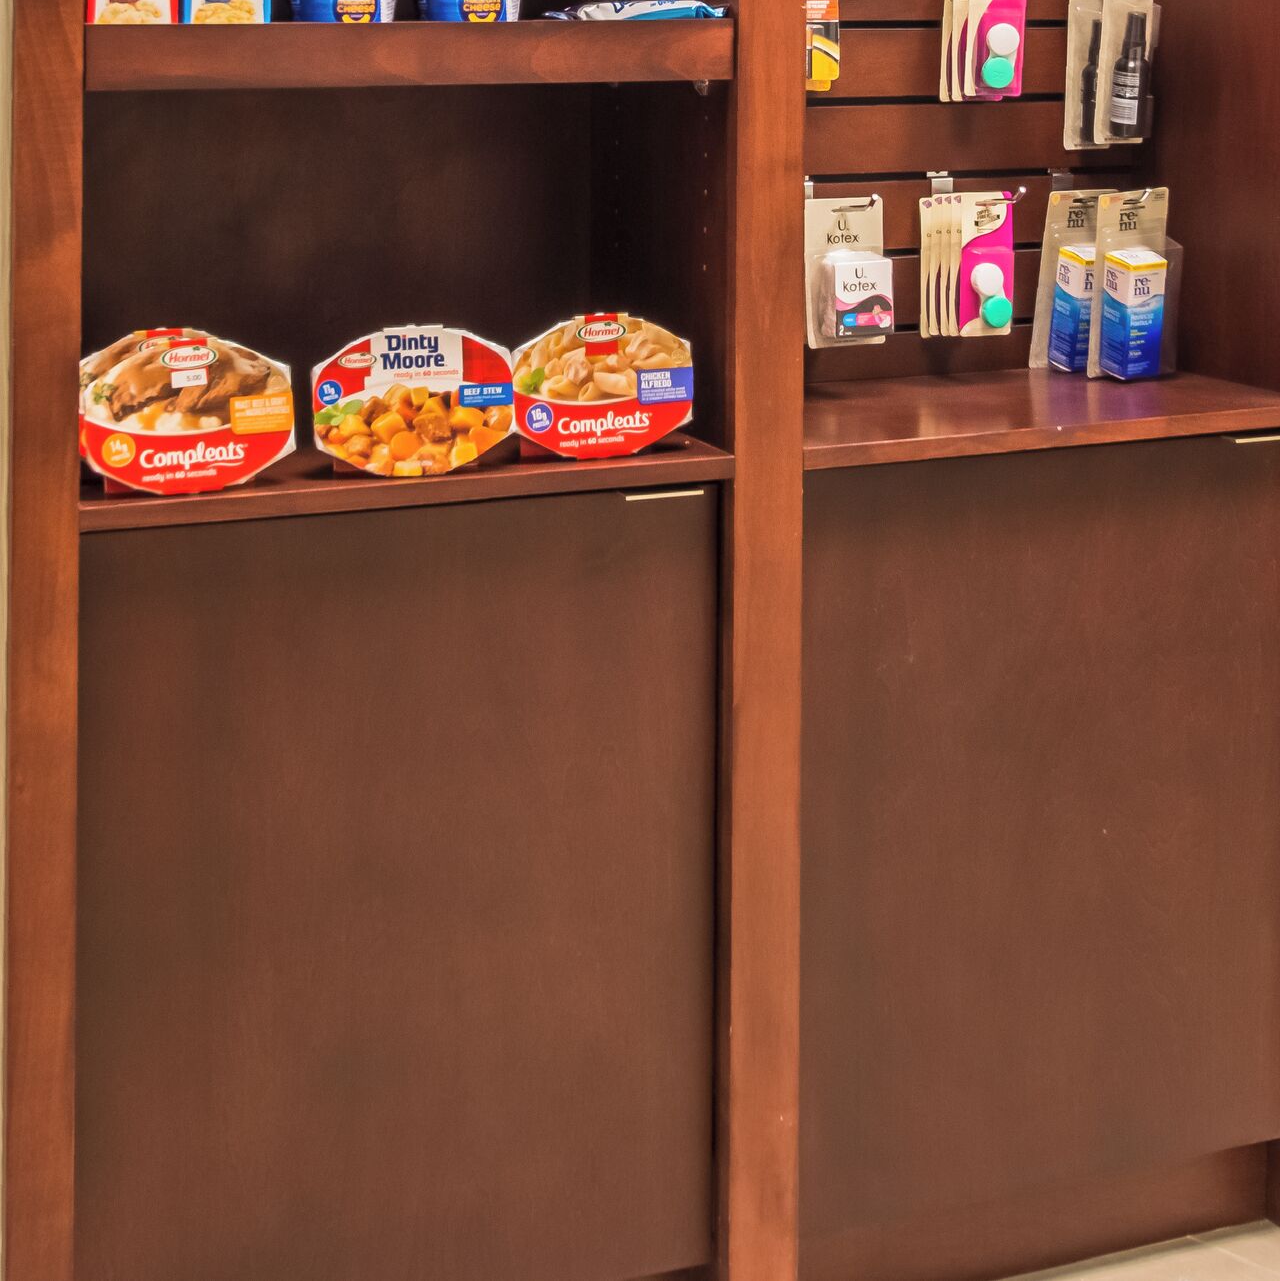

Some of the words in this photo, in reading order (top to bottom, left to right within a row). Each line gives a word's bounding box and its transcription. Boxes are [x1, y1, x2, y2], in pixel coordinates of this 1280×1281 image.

[837, 220, 847, 232] U
[1066, 219, 1085, 229] nu
[1119, 221, 1137, 232] nu
[854, 267, 864, 279] U
[1134, 287, 1150, 296] nu
[584, 325, 621, 337] Hormel
[839, 325, 845, 336] 2
[384, 335, 439, 353] Dinty
[168, 350, 210, 363] Hormel
[344, 355, 372, 365] Hormel
[380, 353, 445, 370] Moore
[394, 371, 413, 379] ready
[433, 369, 459, 377] seconds
[640, 371, 671, 380] CHICKEN
[641, 379, 672, 389] ALFREDO
[464, 387, 481, 396] BEEF
[483, 387, 503, 395] STEW
[558, 411, 650, 436] Compleats
[560, 439, 580, 448] ready
[588, 437, 597, 445] 60
[598, 435, 625, 444] seconds
[139, 441, 245, 470] Compleats
[142, 472, 165, 483] ready
[166, 471, 174, 480] in
[174, 471, 186, 480] 60
[186, 467, 217, 478] seconds
